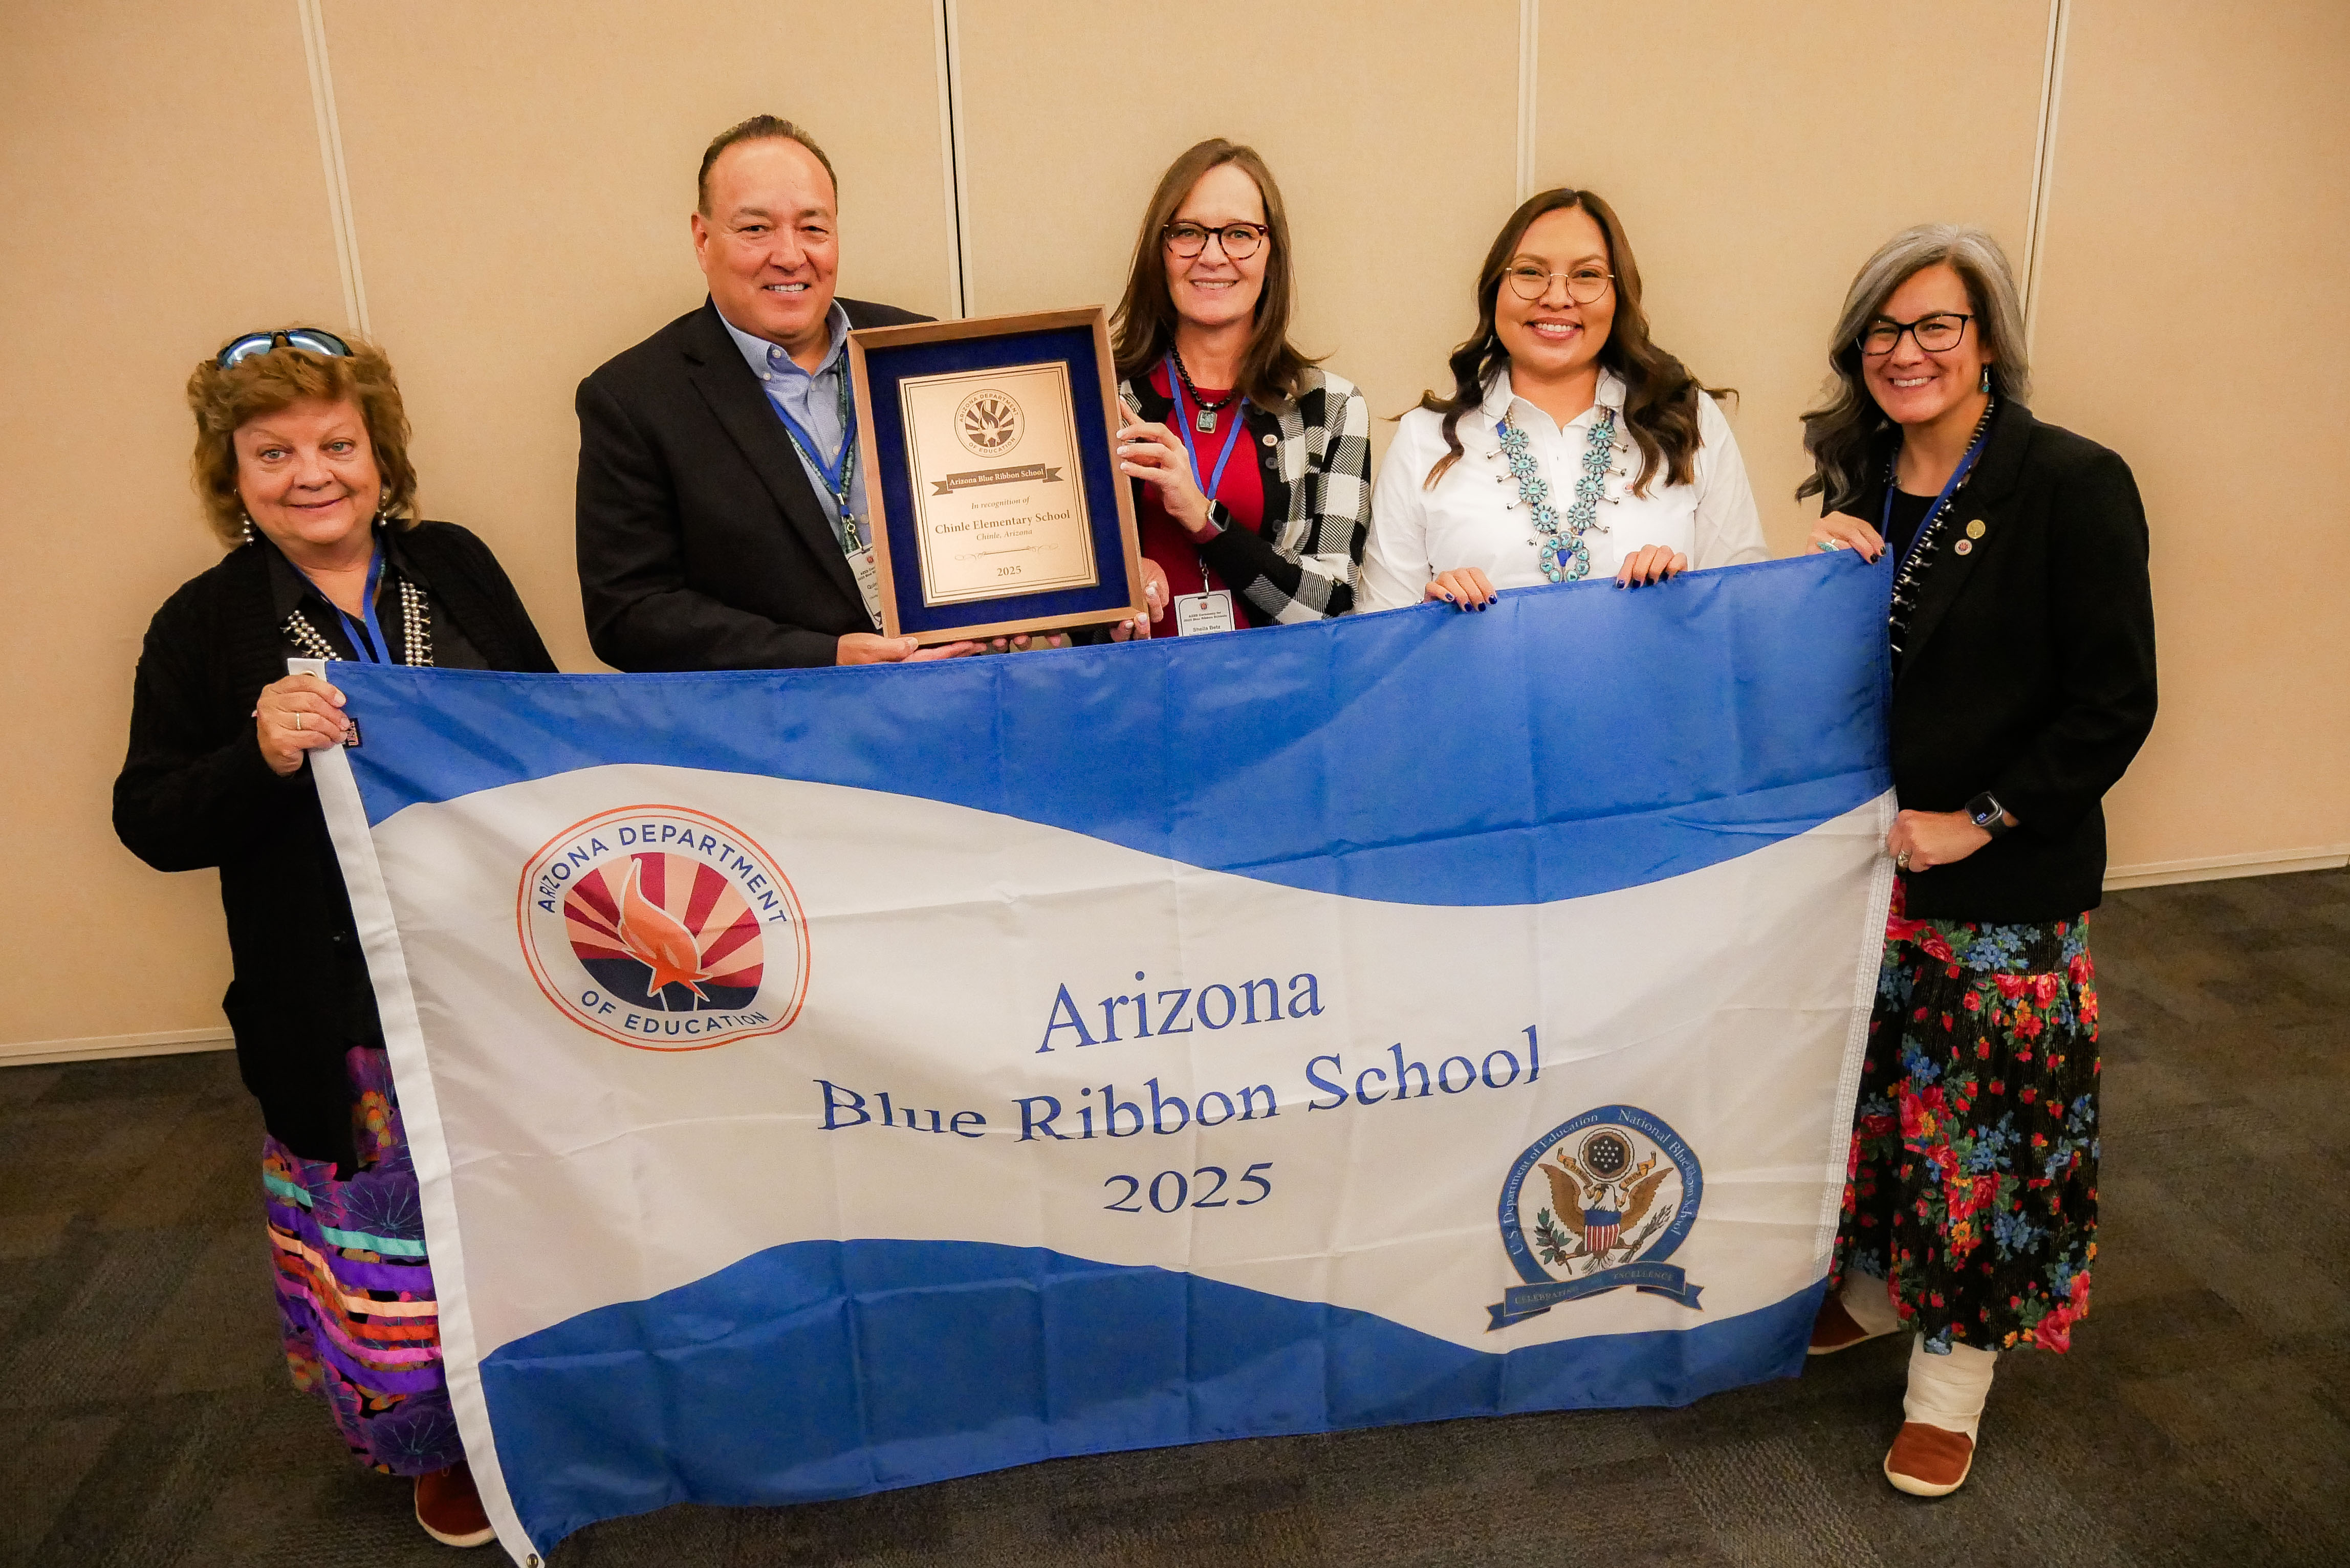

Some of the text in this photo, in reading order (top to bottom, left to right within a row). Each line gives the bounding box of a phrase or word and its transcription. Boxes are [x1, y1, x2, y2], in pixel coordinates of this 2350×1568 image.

[959, 394, 1019, 422] ARIZONA DEPARTMENT
[979, 437, 1015, 453] EDUCATION
[949, 477, 976, 486] Arizona
[1021, 468, 1043, 477] School
[981, 498, 1020, 508] recognition
[1022, 495, 1031, 504] of
[935, 509, 1070, 534] Chinle Elementary School
[976, 529, 1032, 541] Chinle, Arizona
[997, 565, 1021, 576] 2025
[537, 824, 787, 922] ARIZONA DEPARTMENT
[581, 990, 770, 1035] OF EDUCATION
[1035, 970, 1325, 1053] Arizona
[813, 1024, 1541, 1143] Blue Ribbon School
[1618, 1108, 1670, 1143] National
[1669, 1141, 1689, 1166] Blue
[1103, 1162, 1273, 1213] 2025
[1504, 1161, 1530, 1224] Department
[1530, 1145, 1540, 1159] of
[1539, 1115, 1598, 1148] Education
